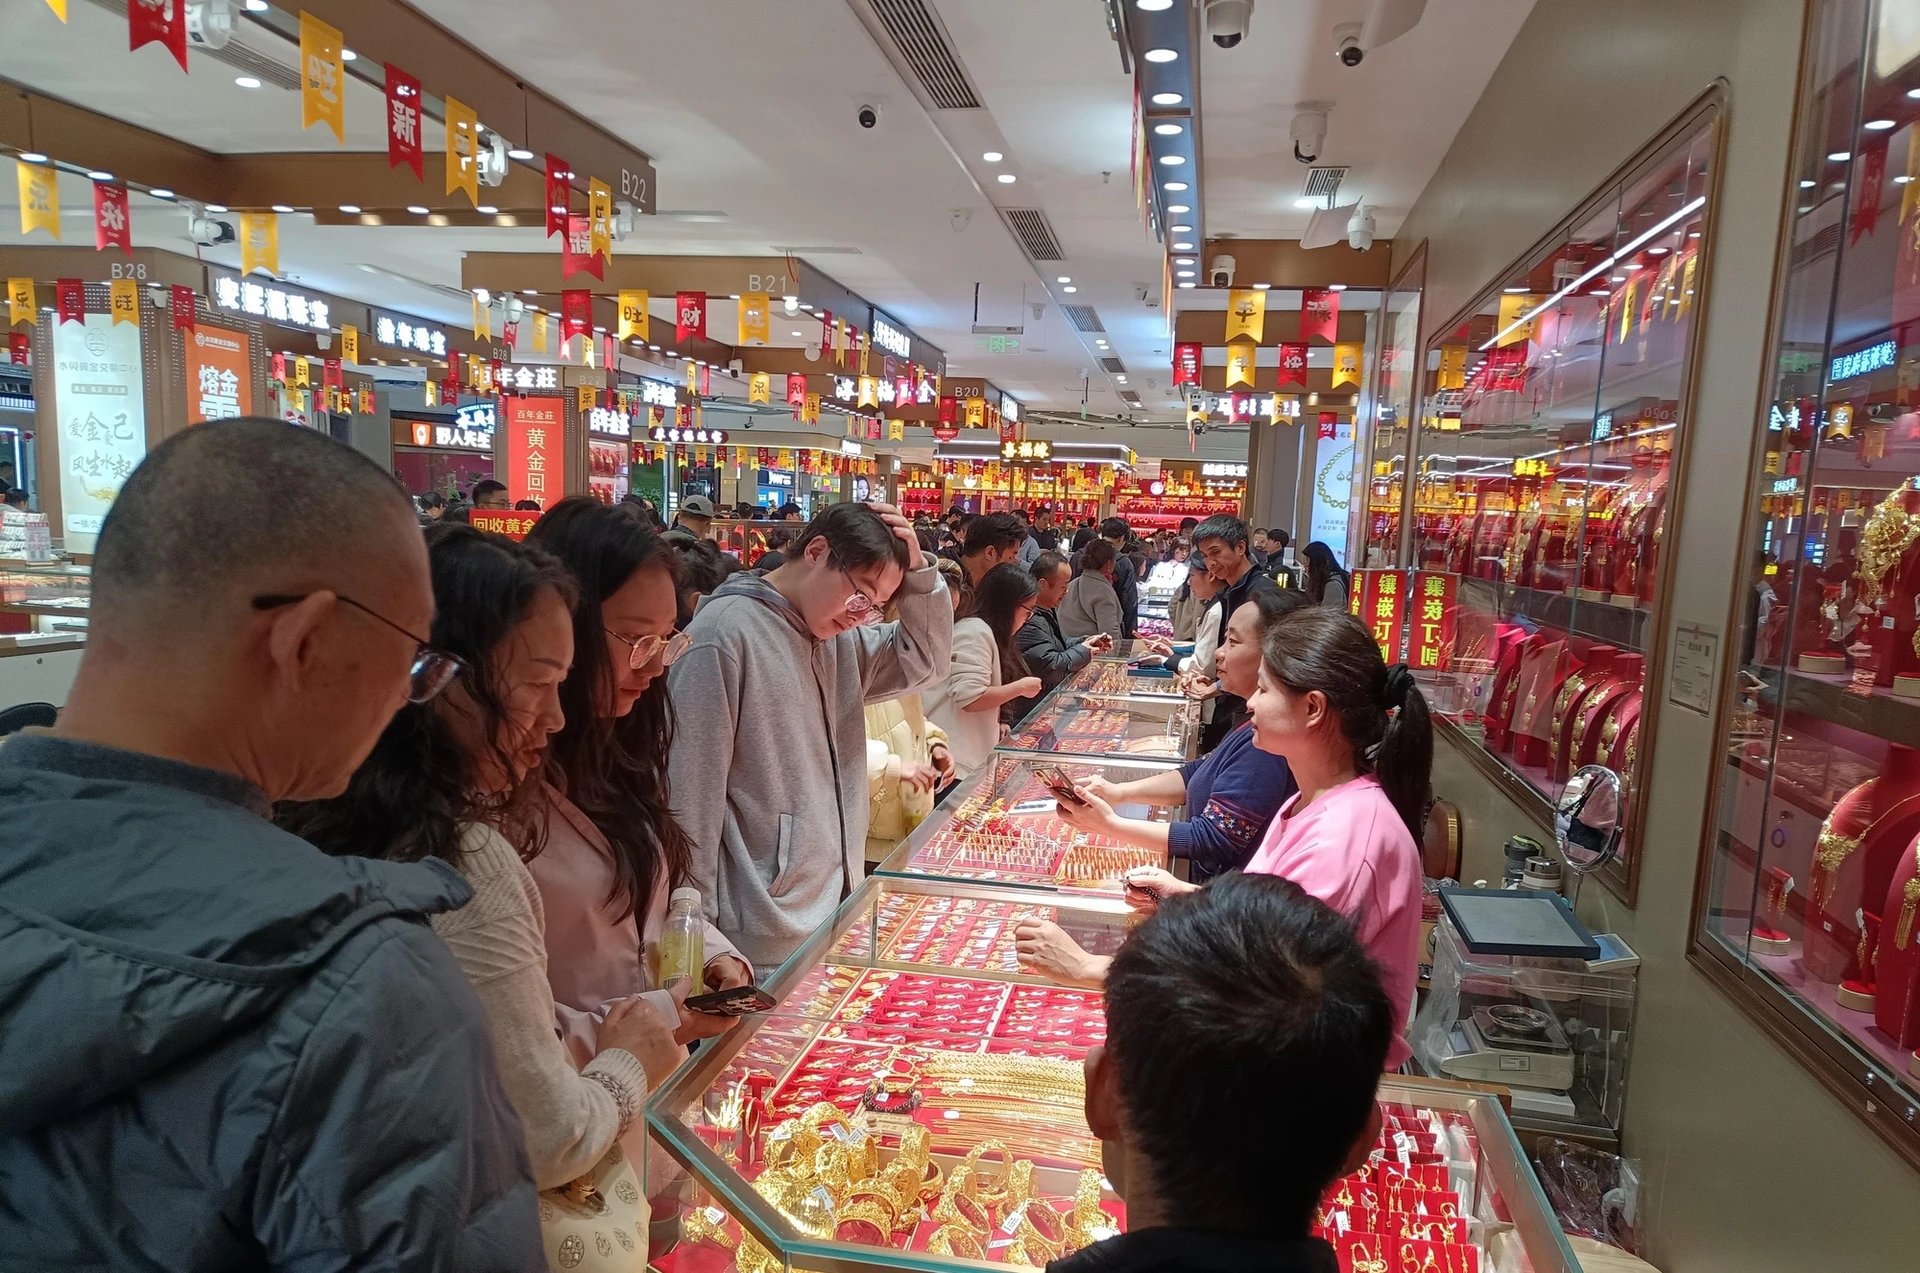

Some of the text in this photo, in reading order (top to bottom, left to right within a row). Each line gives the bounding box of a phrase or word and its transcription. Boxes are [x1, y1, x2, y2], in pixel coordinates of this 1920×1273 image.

[390, 98, 417, 147] 新
[621, 168, 646, 204] B22
[110, 263, 147, 280] B28
[748, 274, 787, 292] B21
[623, 304, 644, 324] 旺
[680, 307, 702, 328] 财
[743, 308, 765, 328] 旺
[492, 347, 508, 361] B28
[58, 360, 138, 374] 水贝黄金交易中心
[198, 364, 241, 396] 熔金
[579, 375, 600, 385] B27
[583, 392, 593, 404] 乐
[955, 386, 979, 397] B20
[516, 409, 555, 421] 百年金莊
[969, 405, 982, 416] 旺
[68, 411, 134, 446] 爱金爱己
[435, 425, 492, 449] 野人先生
[1001, 441, 1051, 459] 喜福缘
[72, 450, 133, 479] 风生水起
[525, 428, 547, 515] 黄金回收
[473, 517, 536, 535] 回收黄金
